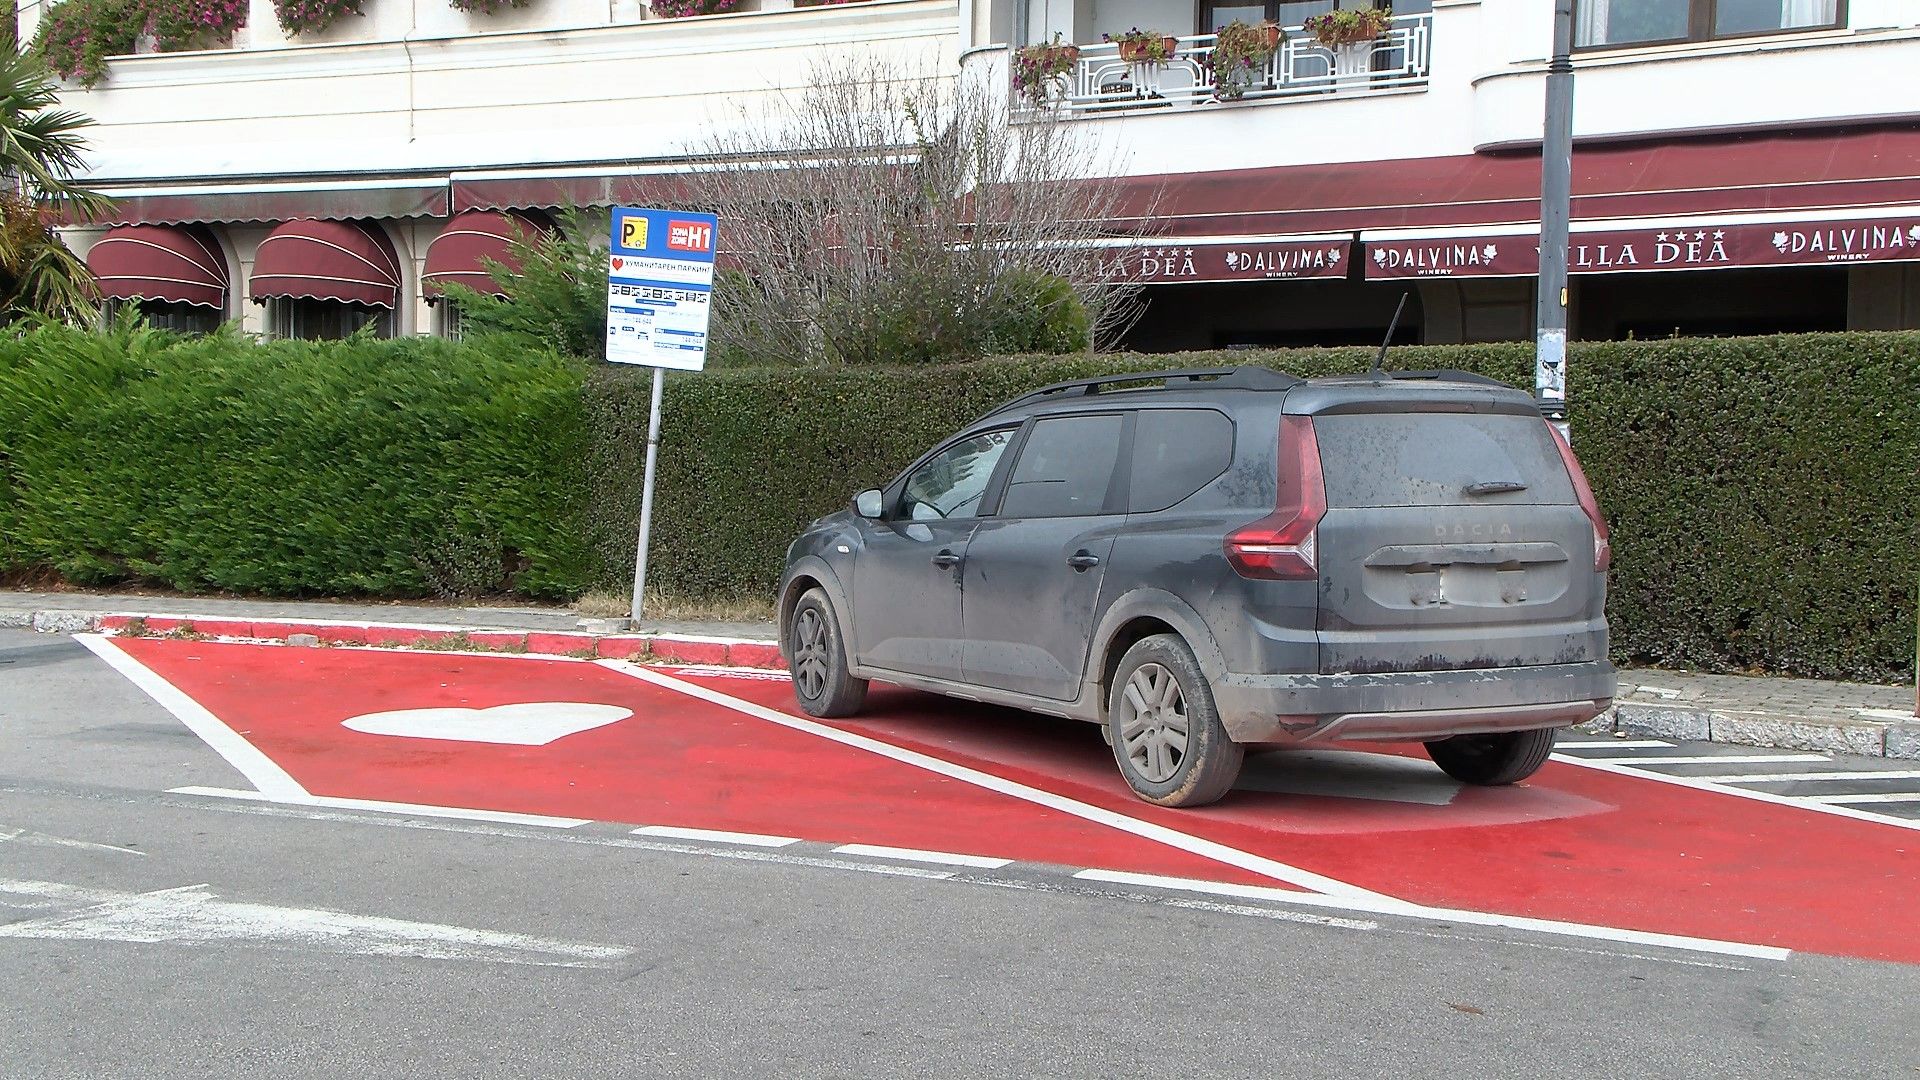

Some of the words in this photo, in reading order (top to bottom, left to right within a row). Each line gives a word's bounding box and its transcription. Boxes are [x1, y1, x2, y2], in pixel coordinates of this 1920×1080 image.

[623, 223, 635, 243] P
[688, 226, 711, 249] H1
[1791, 226, 1904, 253] DALVINA
[1240, 248, 1325, 271] DALVINA
[1388, 244, 1480, 268] DALVINA
[1535, 244, 1639, 268] LLA
[1654, 240, 1730, 264] DEA
[1827, 253, 1870, 261] WINERY
[625, 260, 676, 271] ХУМАНИТАРЕН
[677, 264, 711, 274] ПАРКИНГ
[1140, 257, 1198, 277] DEA
[1434, 523, 1513, 537] DACIA
